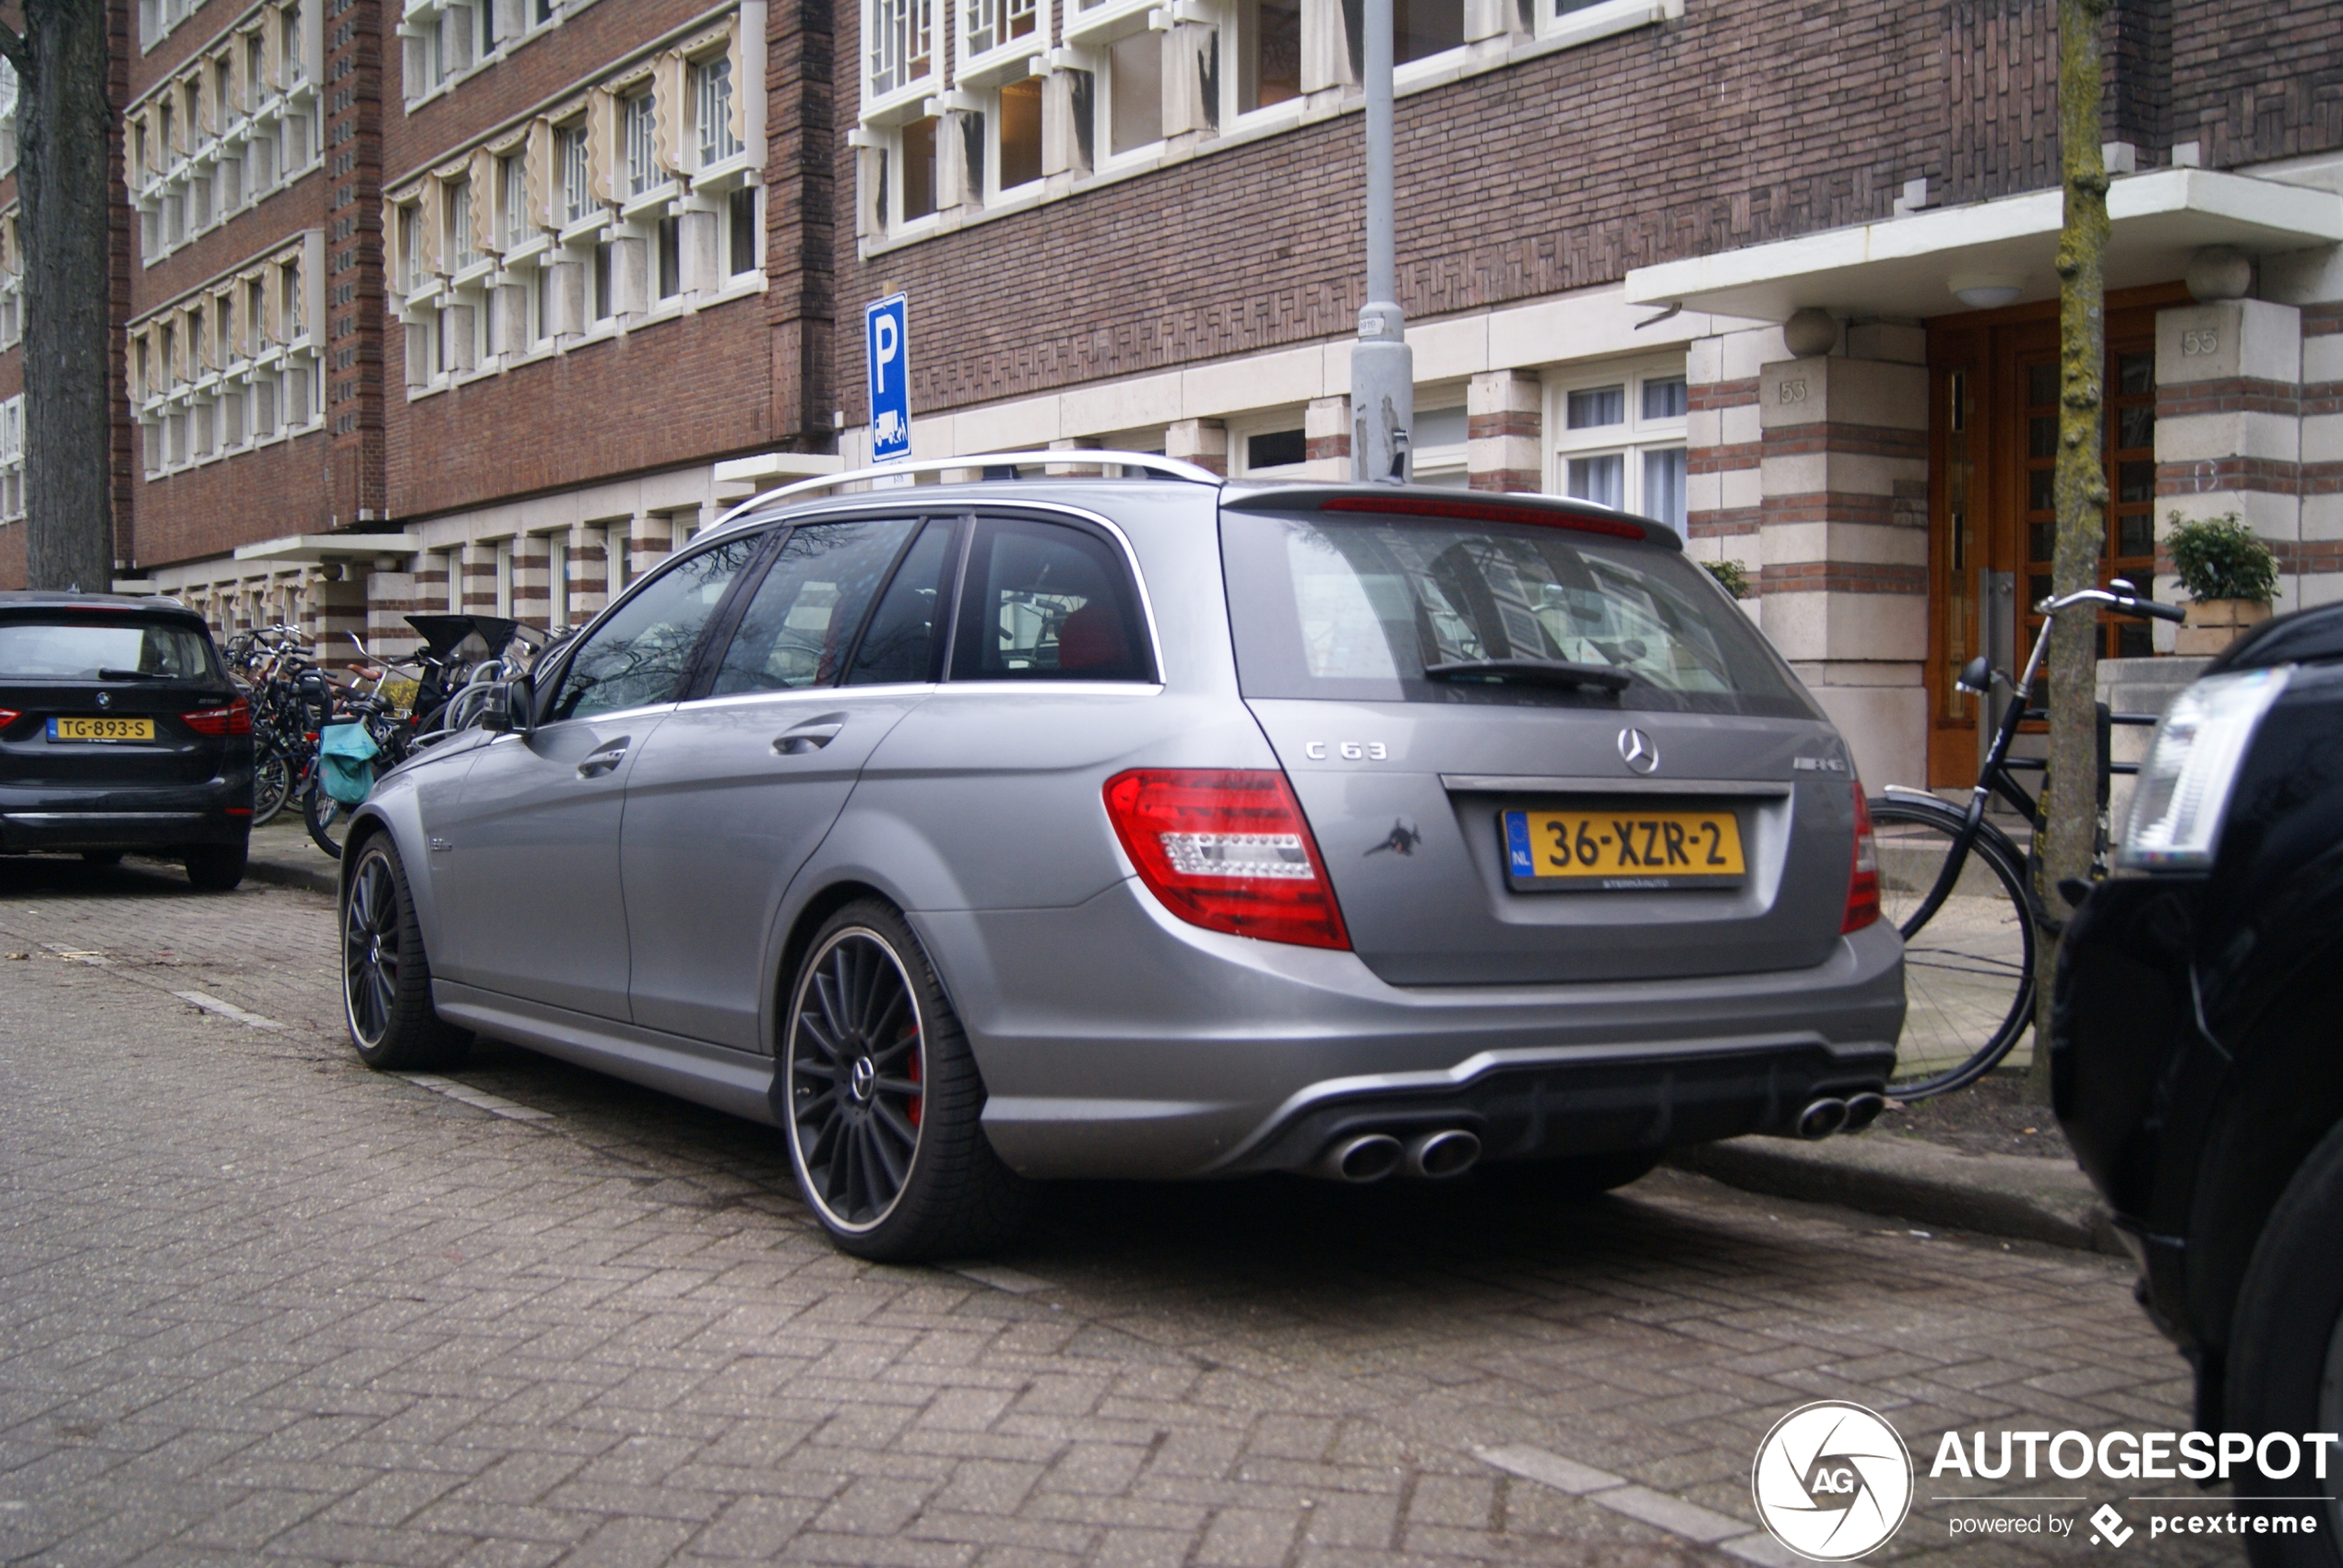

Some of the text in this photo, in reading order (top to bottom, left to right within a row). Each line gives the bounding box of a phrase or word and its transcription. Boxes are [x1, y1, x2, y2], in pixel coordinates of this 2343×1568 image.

[875, 314, 898, 394] P
[2182, 329, 2218, 356] 55
[1780, 379, 1806, 404] 53
[63, 720, 146, 737] TG-893-S
[1306, 742, 1387, 761] C 63
[1546, 820, 1727, 867] 36-XZR-2
[1512, 850, 1531, 866] NL
